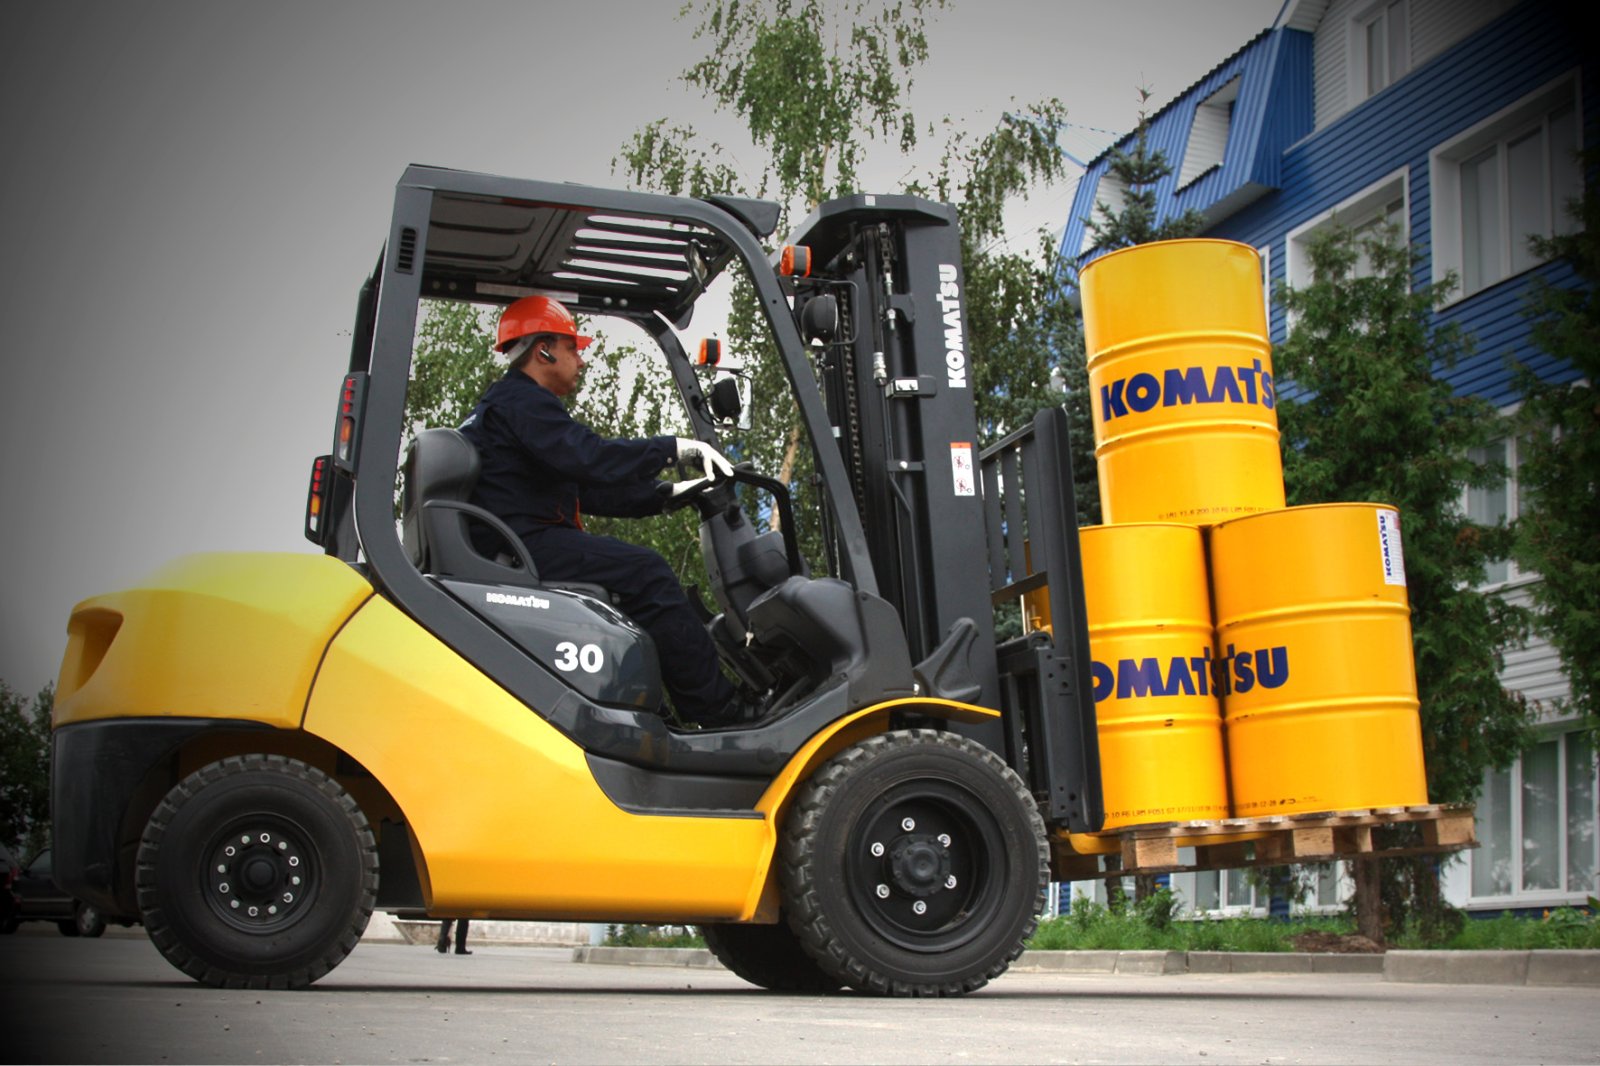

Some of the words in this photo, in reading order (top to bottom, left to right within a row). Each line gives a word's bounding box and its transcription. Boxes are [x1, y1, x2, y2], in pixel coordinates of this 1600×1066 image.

[936, 263, 967, 388] KOMATSU
[1101, 358, 1274, 422] KOMATS
[1379, 515, 1392, 576] KOMATSU
[486, 592, 550, 609] KOMATSU
[554, 641, 604, 673] 30
[1221, 643, 1289, 695] TSU
